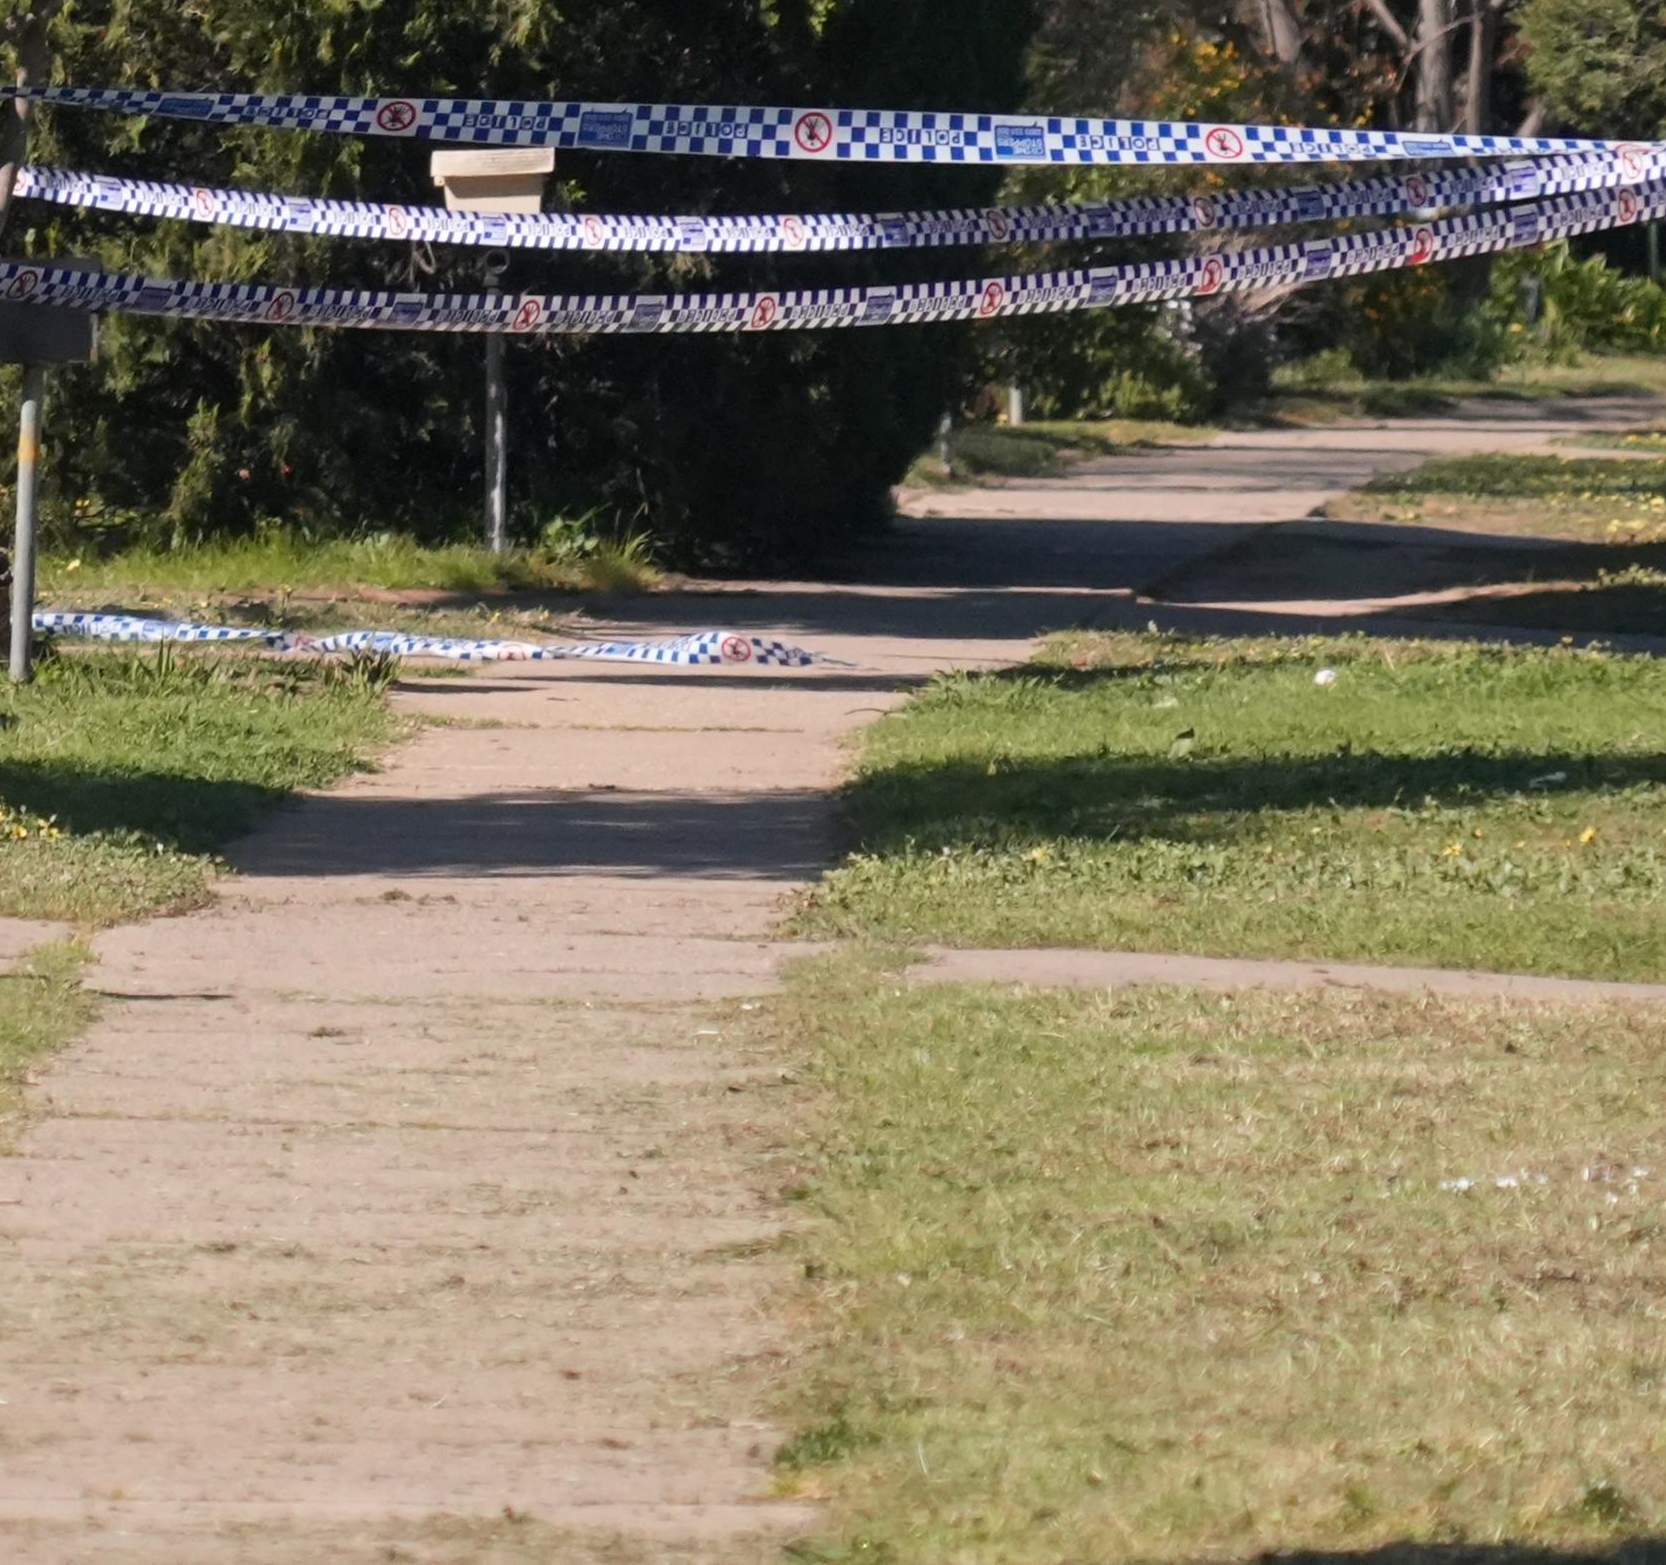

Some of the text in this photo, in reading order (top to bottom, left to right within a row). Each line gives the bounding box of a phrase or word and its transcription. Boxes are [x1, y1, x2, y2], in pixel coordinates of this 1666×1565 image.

[464, 114, 549, 131] POLICE
[664, 121, 747, 138] POLICE
[881, 127, 964, 145] POLICE
[1079, 134, 1160, 152] POLICE
[1290, 141, 1373, 156] POLICE
